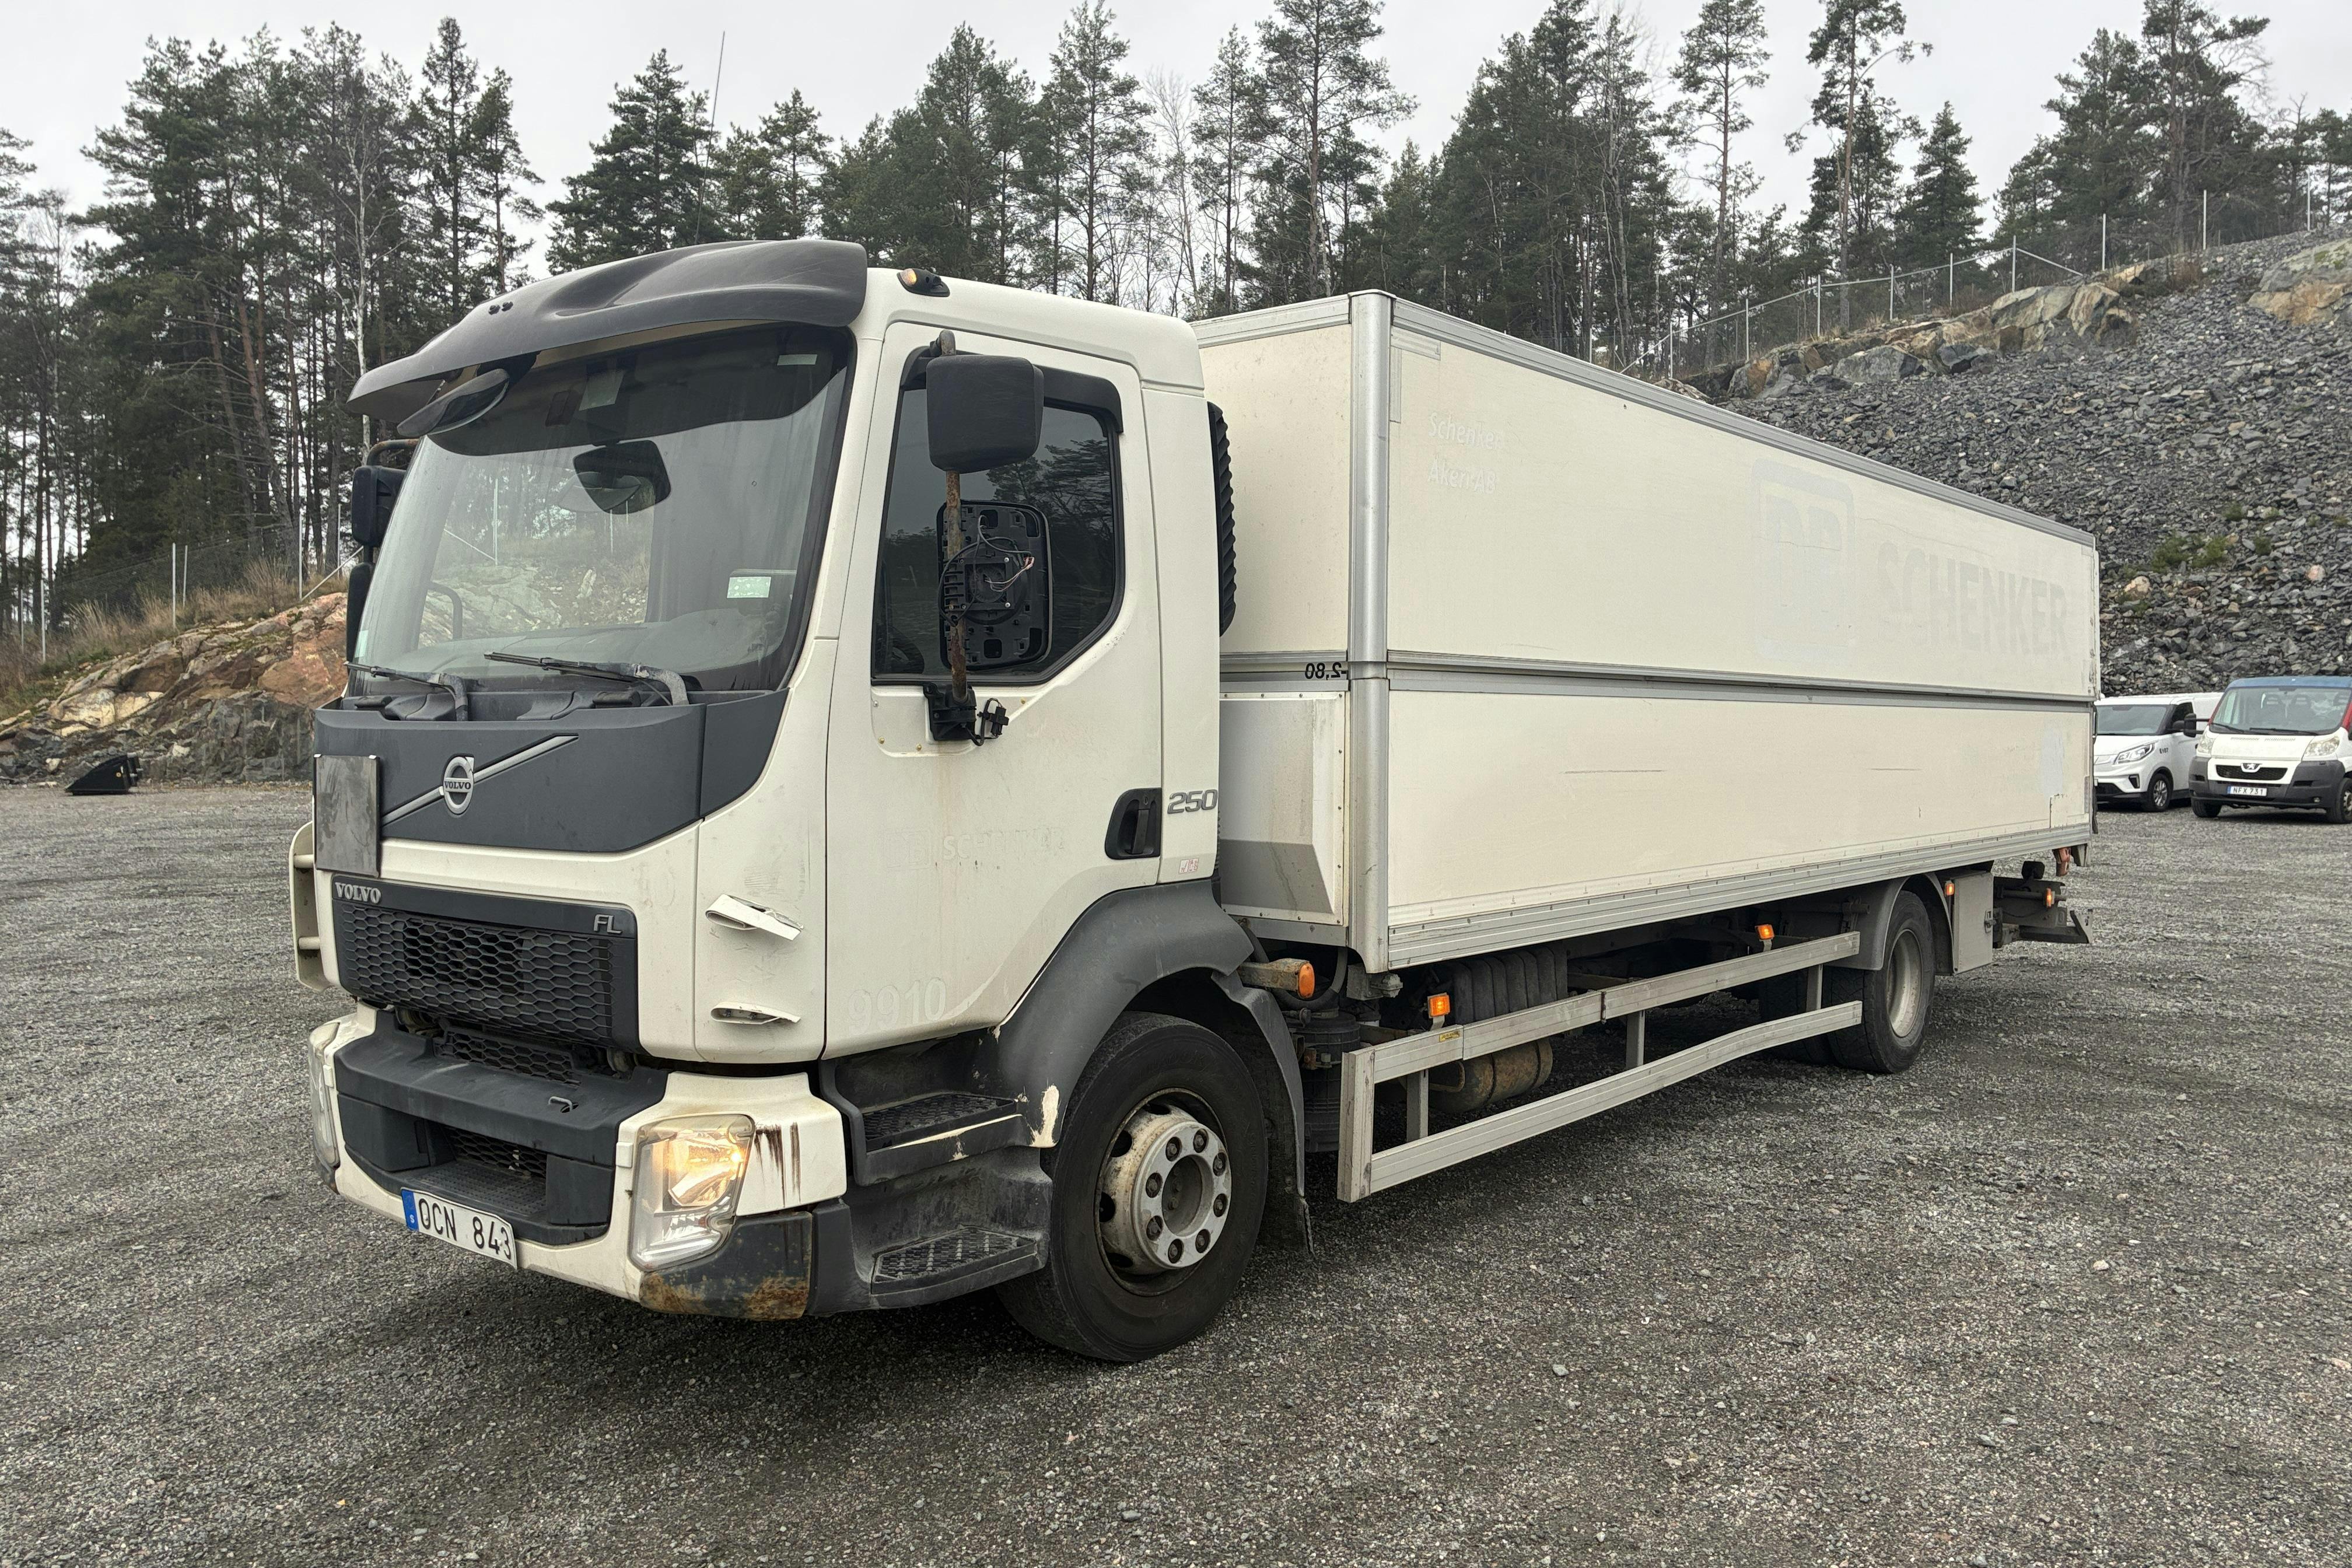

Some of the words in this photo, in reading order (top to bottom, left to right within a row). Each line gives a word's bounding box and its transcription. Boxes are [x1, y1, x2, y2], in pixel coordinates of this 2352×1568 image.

[1878, 540, 2070, 655] SCHENKER
[444, 780, 471, 790] VOLVO
[1167, 789, 1217, 814] 250
[334, 881, 382, 904] VOLVO
[593, 914, 622, 934] FL
[410, 1214, 415, 1224] S
[418, 1198, 457, 1241] OCN
[473, 1216, 511, 1260] 843
